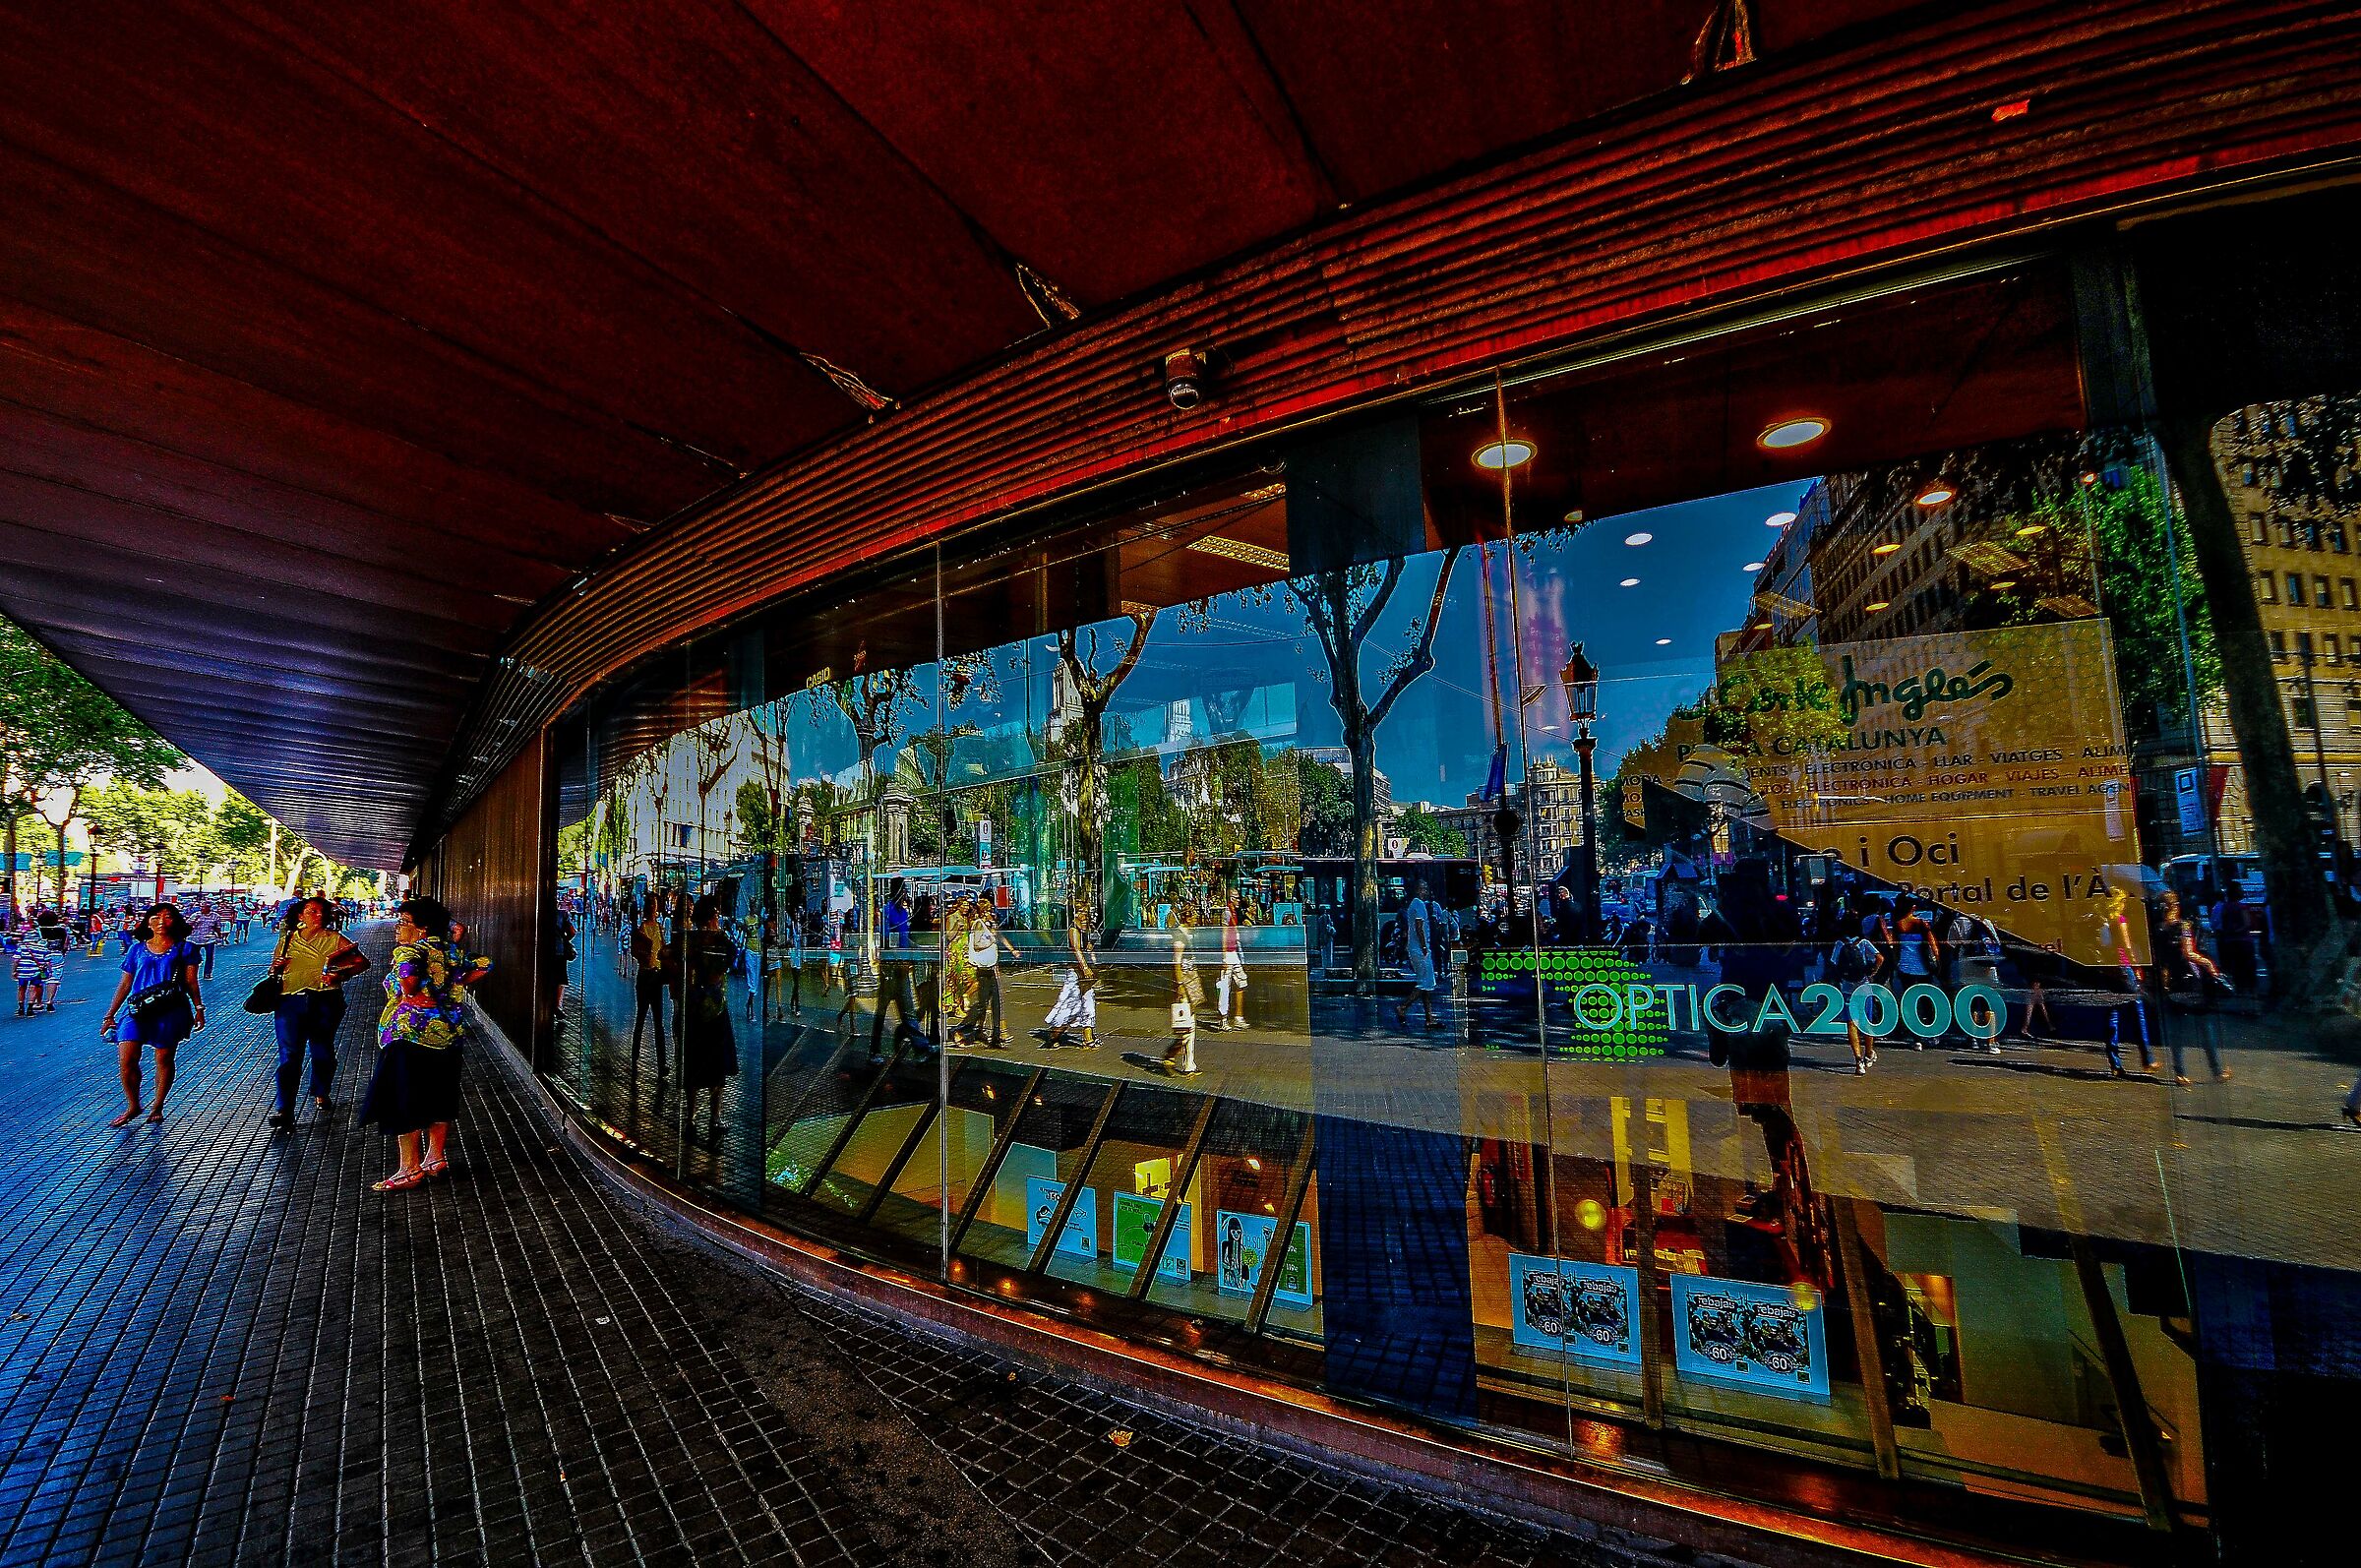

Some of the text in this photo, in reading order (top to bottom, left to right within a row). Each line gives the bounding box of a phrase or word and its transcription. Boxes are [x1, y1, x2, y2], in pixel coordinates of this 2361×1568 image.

[806, 666, 830, 689] CASIO
[1839, 654, 2015, 728] Inglés
[1773, 726, 1948, 756] CATALUNYA
[1934, 754, 1973, 768] LLAR
[1989, 748, 2063, 764] VIATGES
[1928, 772, 1988, 786] HOGAR
[2006, 767, 2060, 782] VIAJES
[1886, 793, 1926, 805] HOME
[1930, 789, 2015, 803] EQUIPMENT
[2029, 785, 2084, 798] TRAVEL
[1886, 831, 1961, 867] Oci
[2007, 874, 2050, 902] de
[1573, 983, 2008, 1039] OPTICA2000
[1583, 1280, 1618, 1295] rebajas
[1698, 1297, 1735, 1310] rebajas
[1757, 1304, 1796, 1318] rebajas
